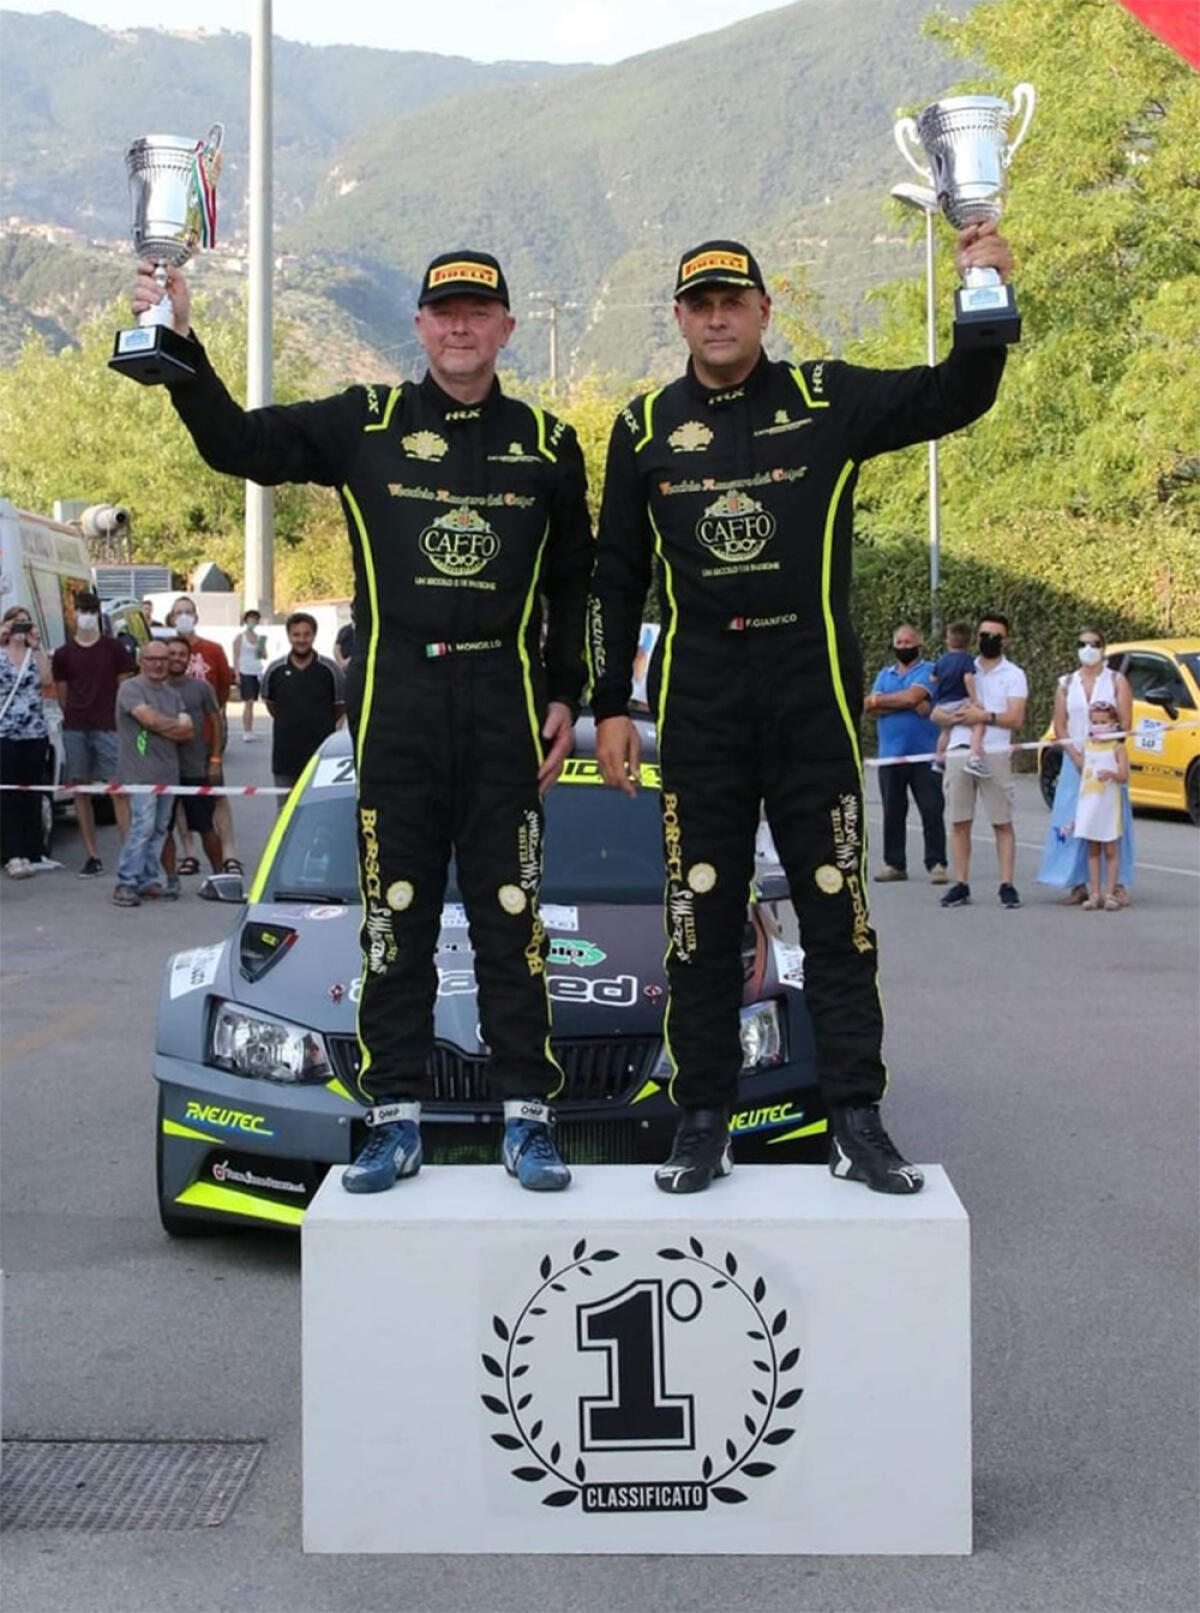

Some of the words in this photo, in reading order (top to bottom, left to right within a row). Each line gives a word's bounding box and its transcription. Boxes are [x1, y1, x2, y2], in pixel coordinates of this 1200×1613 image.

[433, 267, 495, 283] PIRELLI
[683, 257, 745, 276] PIRELLI
[444, 407, 481, 421] HRX
[701, 514, 770, 543] CAFFO
[424, 530, 495, 557] CAFFO
[663, 792, 682, 881] BORSCI
[361, 808, 381, 900] BORSCI
[185, 1101, 274, 1136] PNEUTEC
[728, 1102, 804, 1132] NEUTEC
[585, 1485, 704, 1508] CLASSIFICATO
